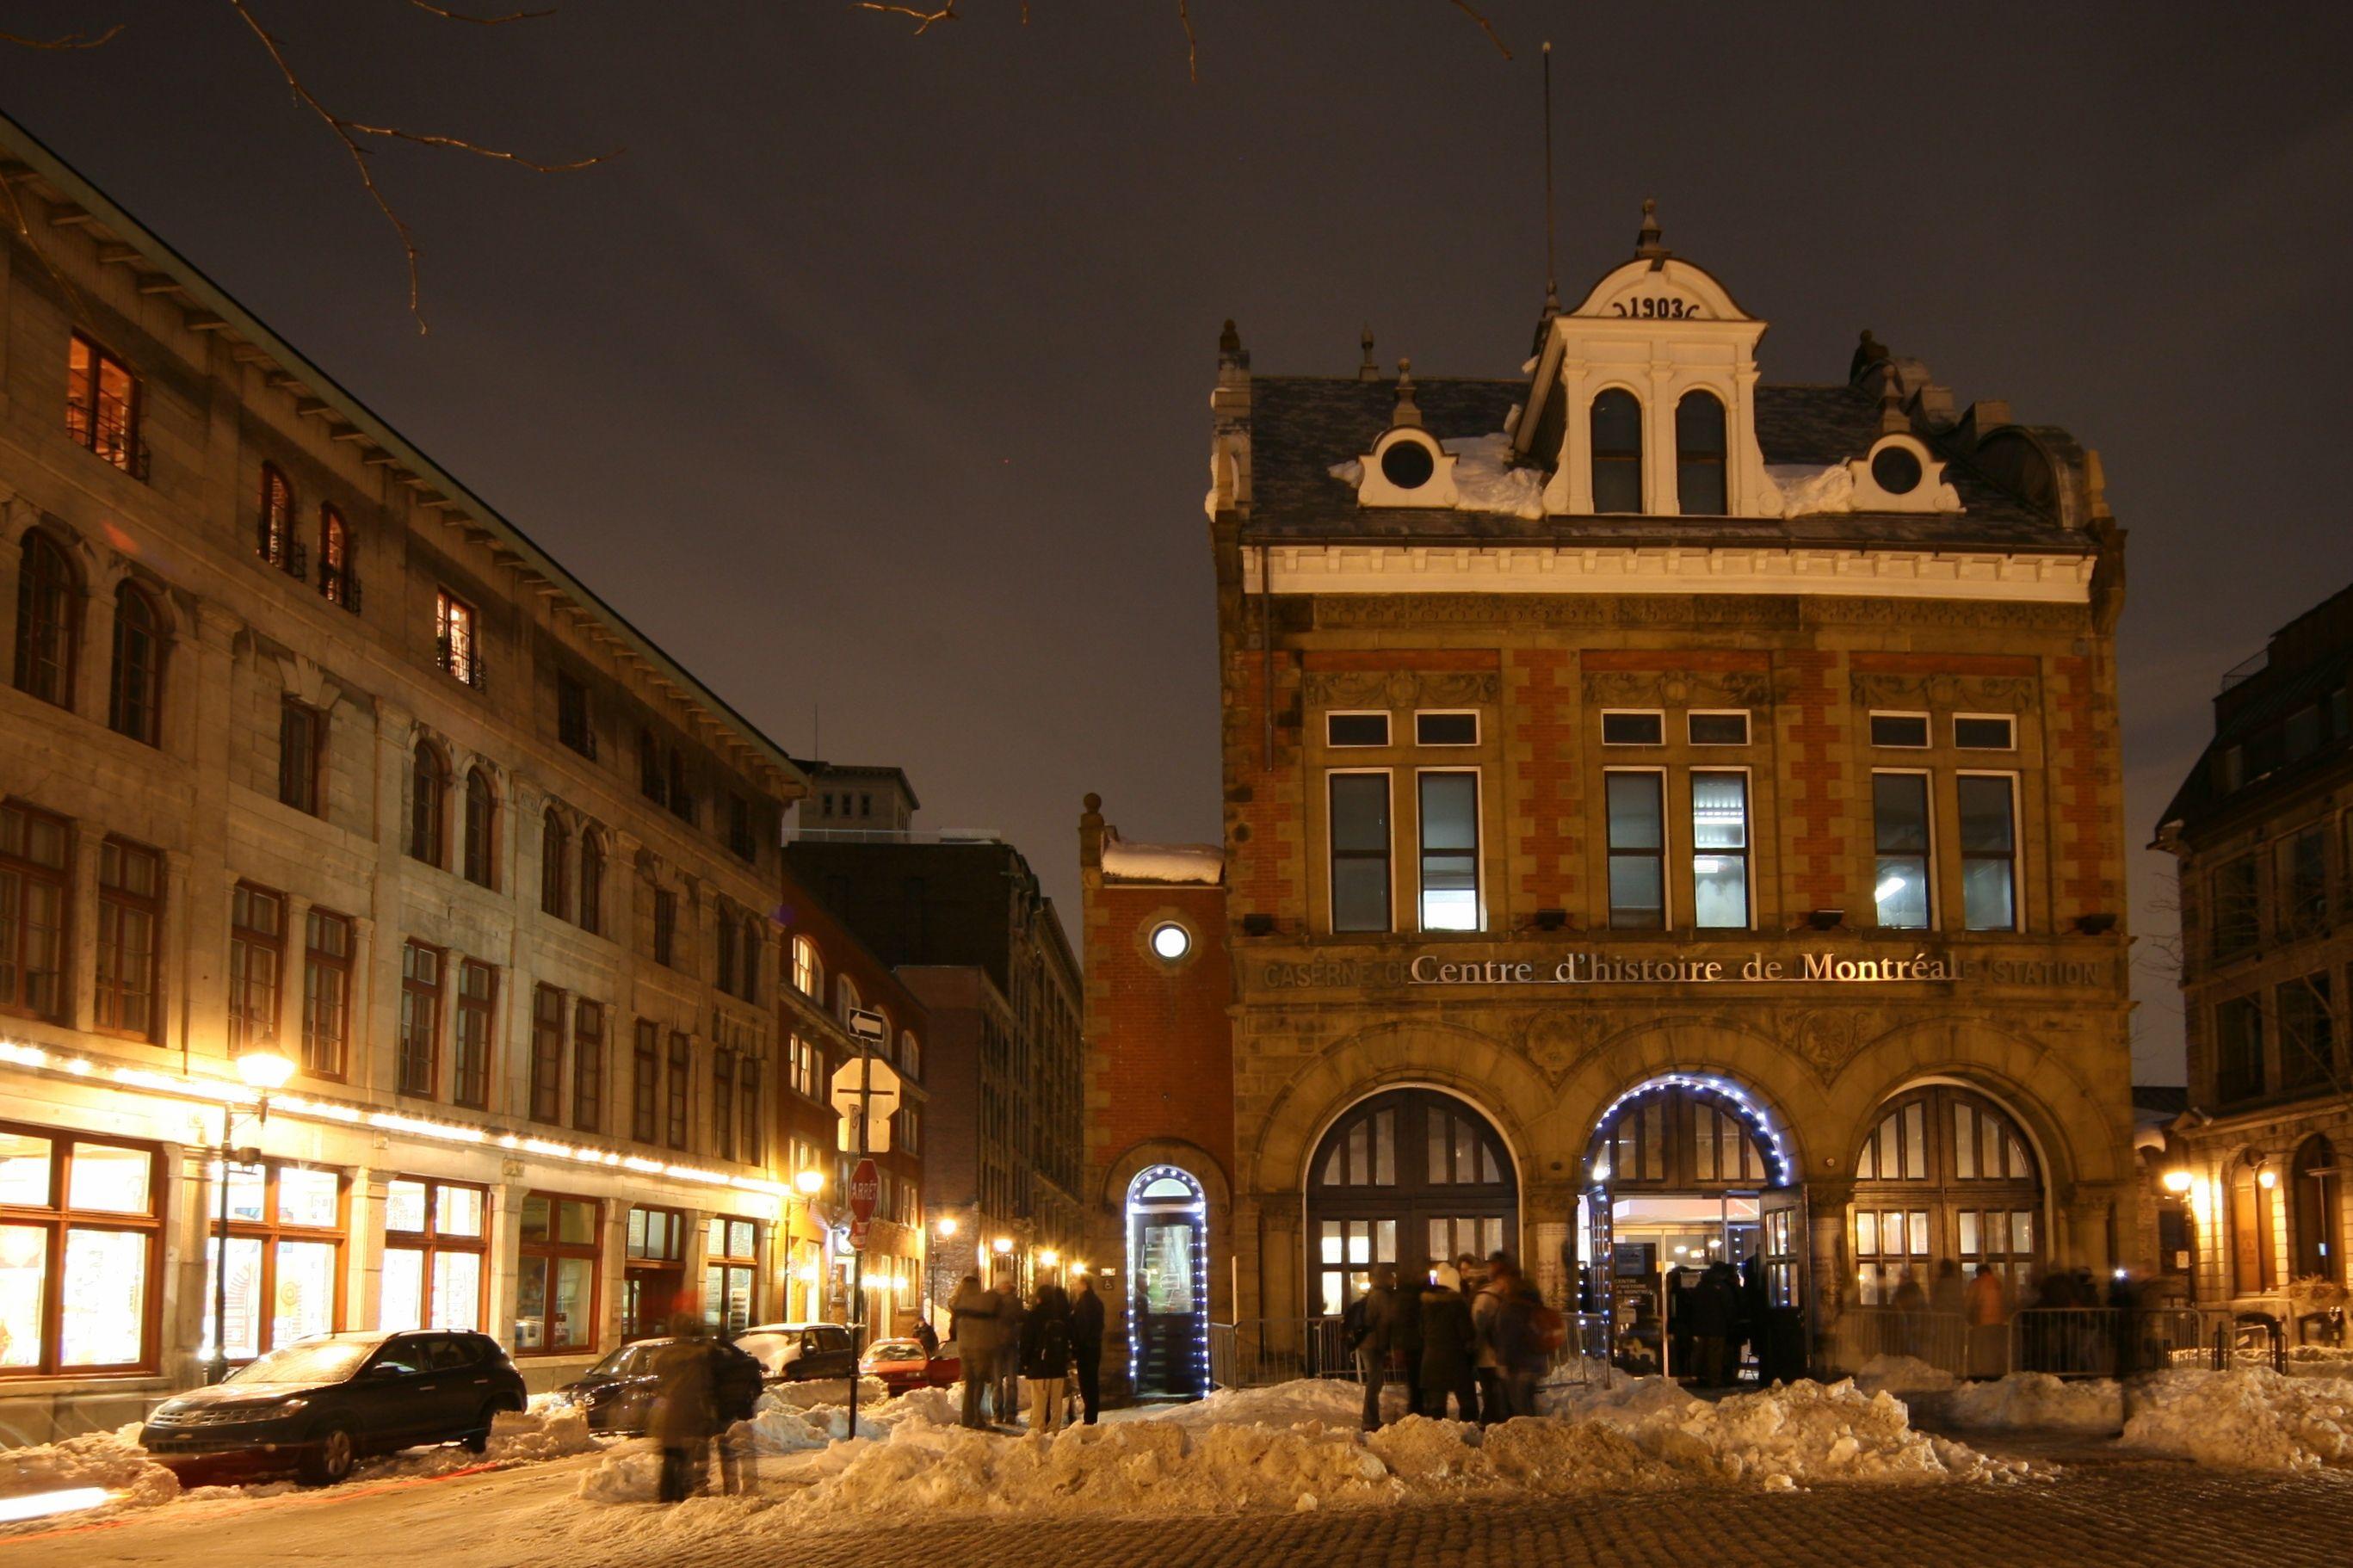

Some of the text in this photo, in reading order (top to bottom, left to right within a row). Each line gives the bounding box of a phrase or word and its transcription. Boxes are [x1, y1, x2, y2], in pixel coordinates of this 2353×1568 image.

[1630, 297, 1683, 318] 1903
[1411, 954, 1532, 983] Centre
[1555, 953, 1722, 982] d'histoire
[1743, 952, 1782, 981] de
[1801, 951, 1957, 981] Montréal
[1992, 960, 2098, 986] STATION
[851, 1180, 877, 1200] ARRÊT
